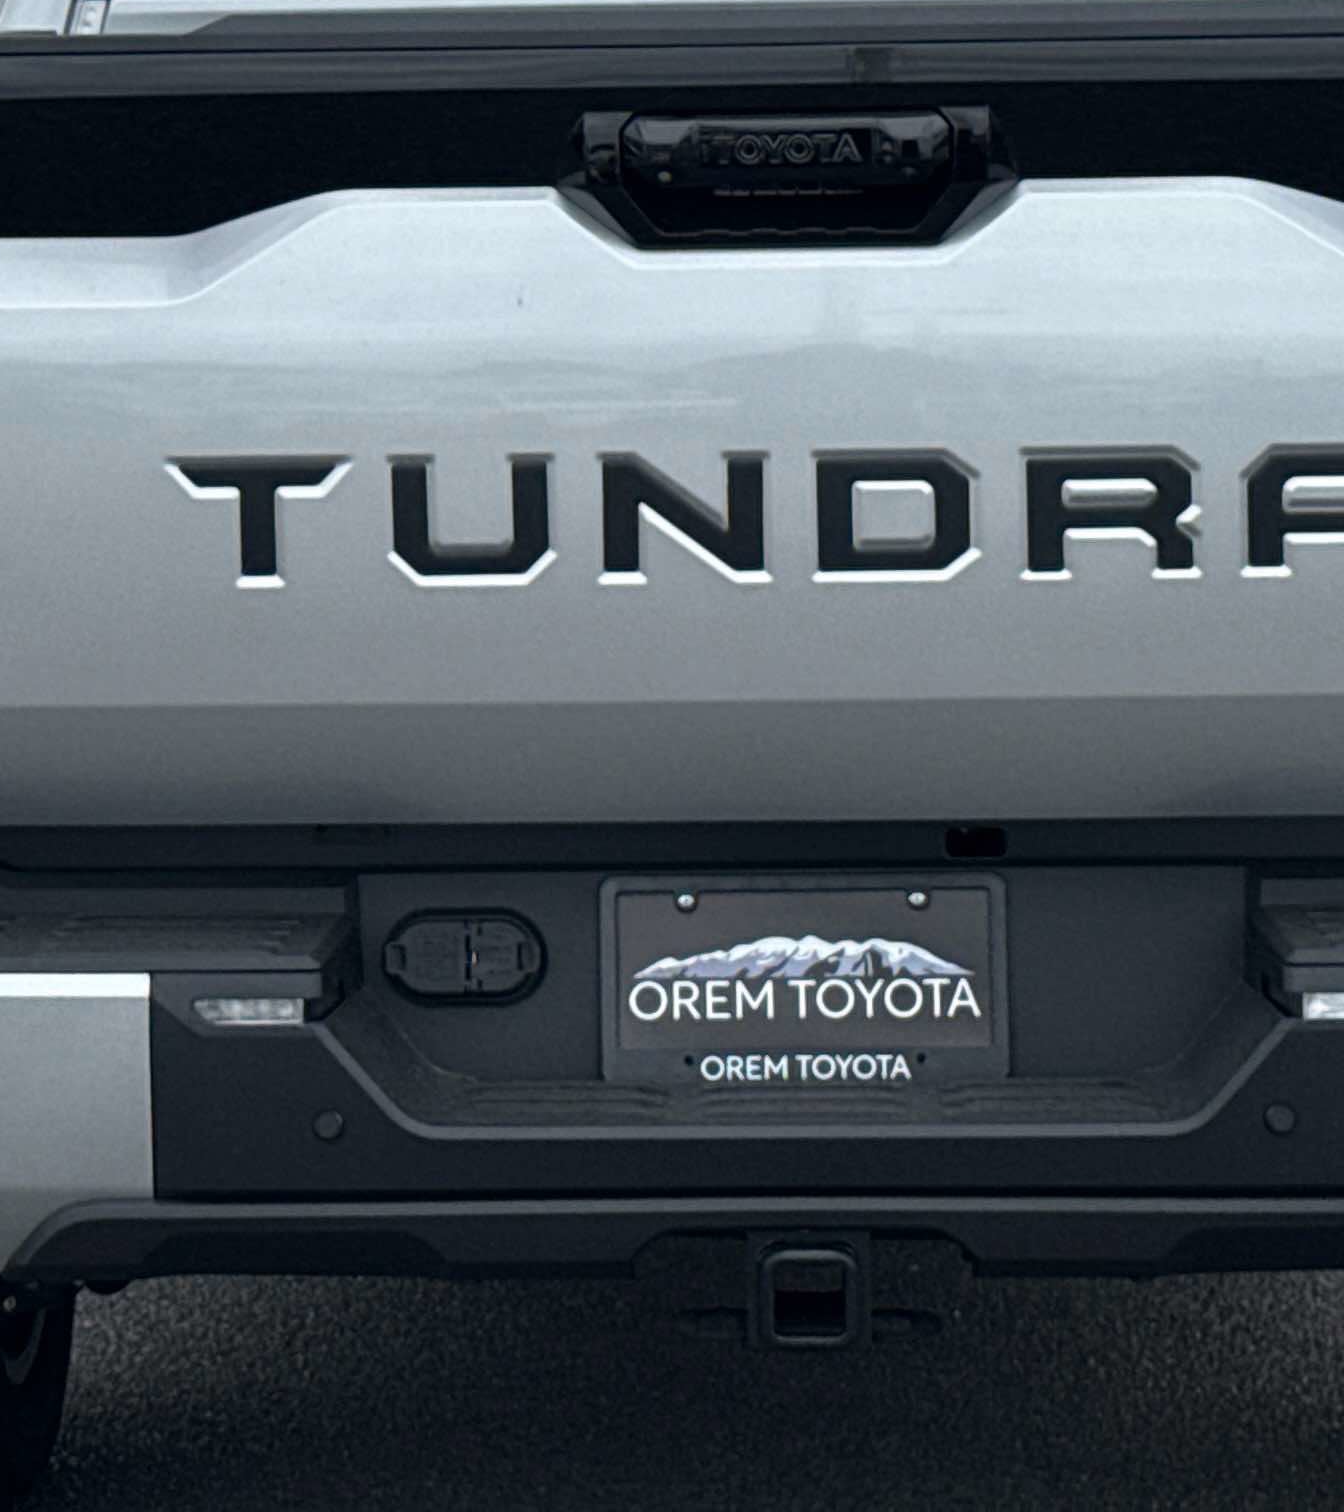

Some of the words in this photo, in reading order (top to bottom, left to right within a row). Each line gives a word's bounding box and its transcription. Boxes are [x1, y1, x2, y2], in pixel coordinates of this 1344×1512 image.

[712, 133, 864, 165] TOYOTA
[628, 980, 776, 1021] OREM
[788, 978, 982, 1019] TOYOTA
[700, 1054, 789, 1082] OREM
[796, 1054, 912, 1080] TOYOTA
